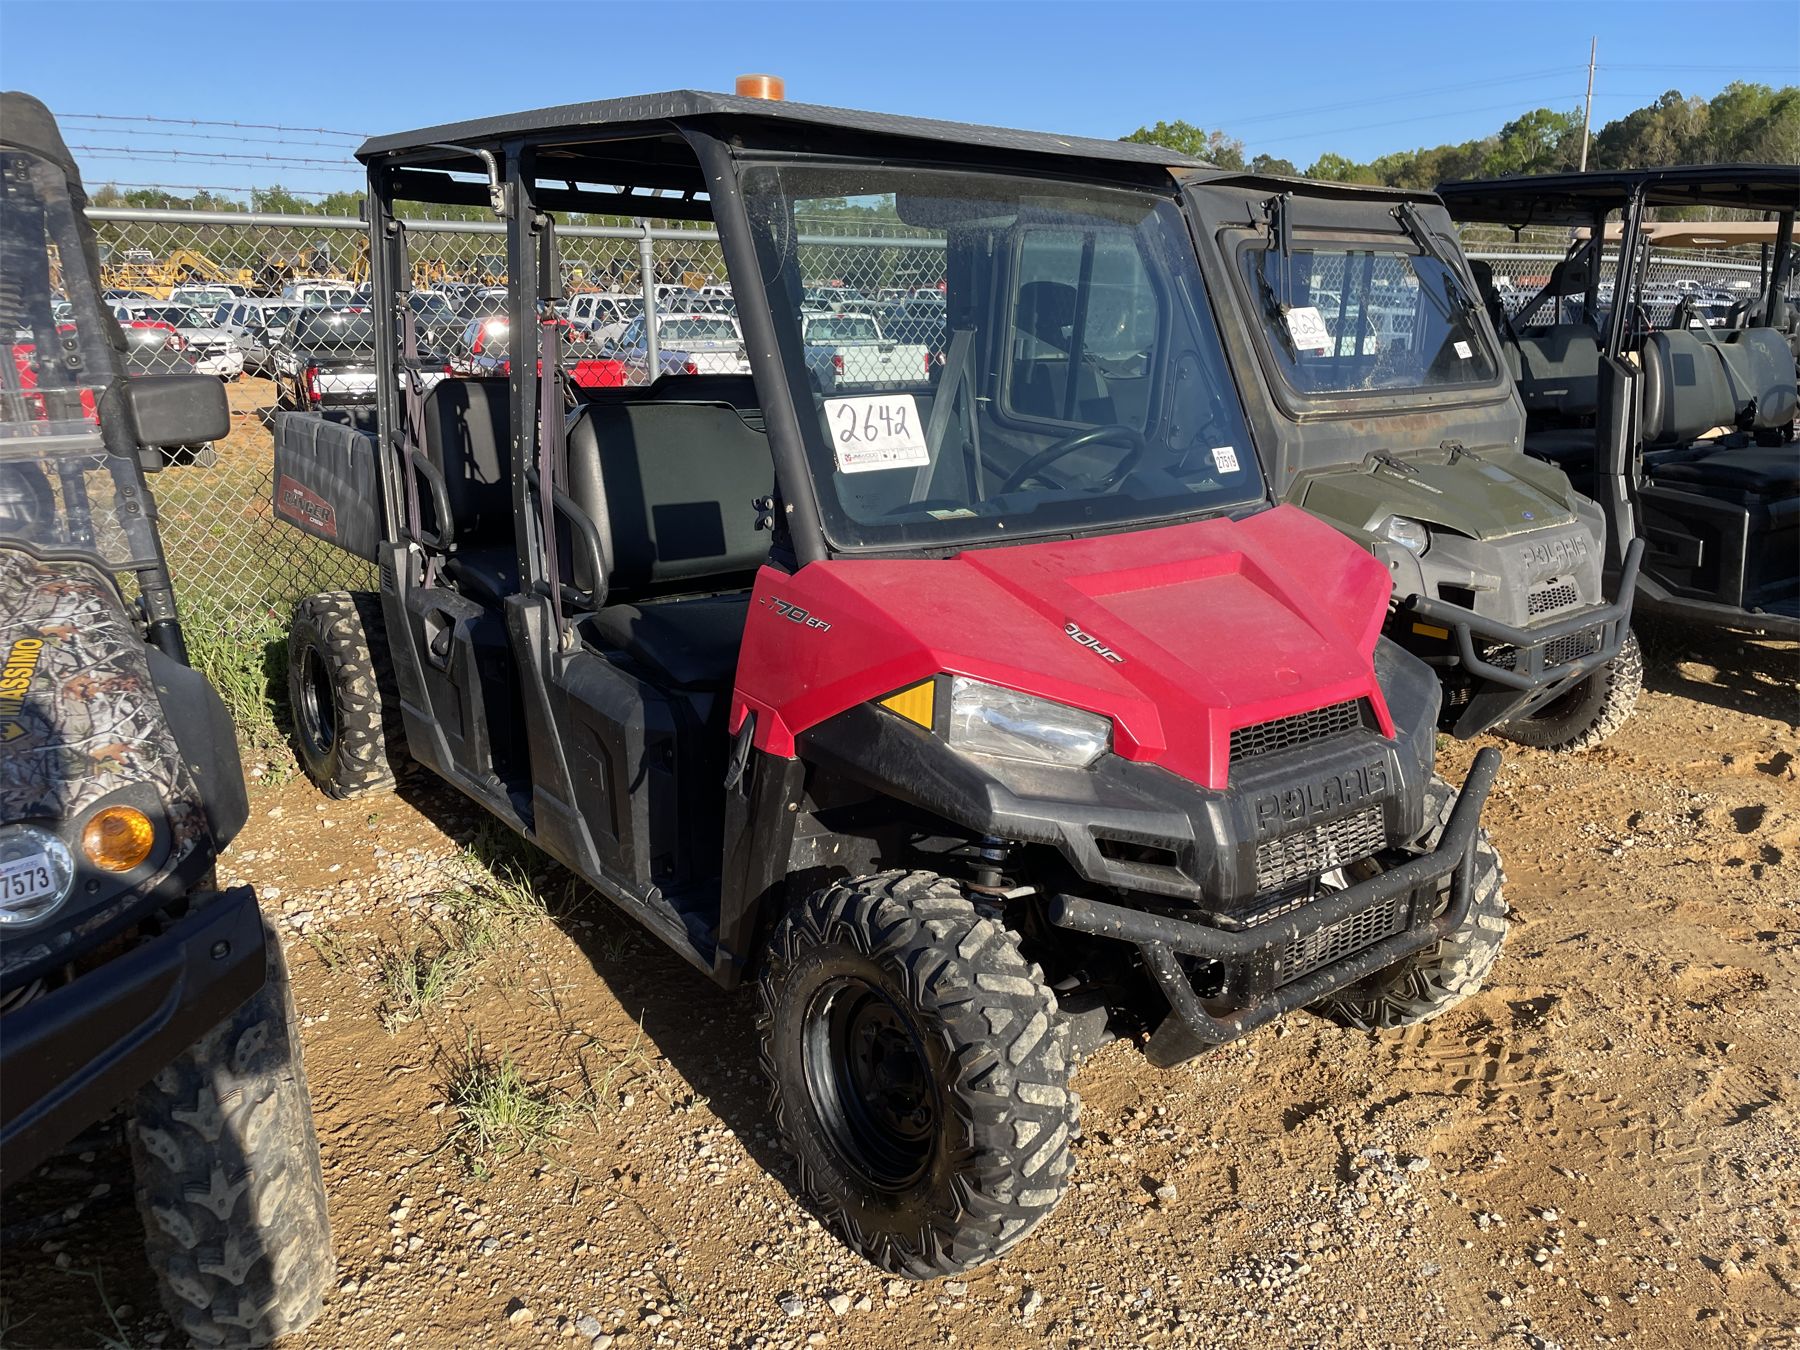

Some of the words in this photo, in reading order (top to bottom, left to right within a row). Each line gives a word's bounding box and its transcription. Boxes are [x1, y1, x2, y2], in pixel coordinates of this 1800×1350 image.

[837, 403, 910, 442] 2642
[1216, 455, 1237, 469] 27519
[284, 490, 330, 522] RANGER
[1520, 536, 1588, 568] POLARIS
[805, 616, 832, 633] EFI
[0, 638, 44, 716] MASSIMO
[1255, 760, 1387, 830] POLARIS
